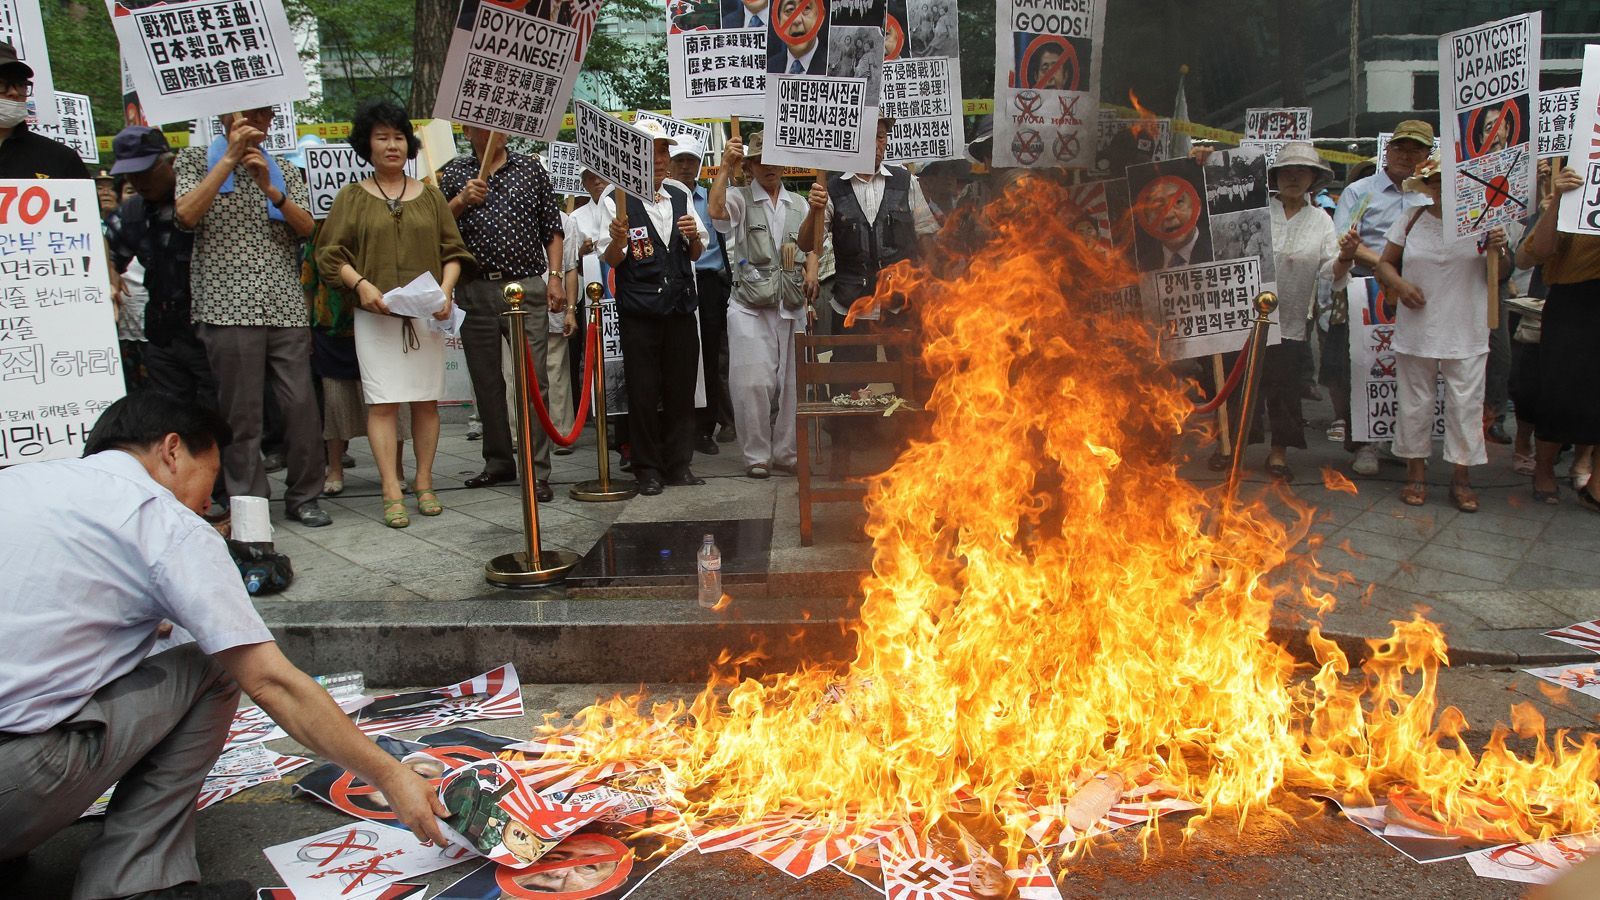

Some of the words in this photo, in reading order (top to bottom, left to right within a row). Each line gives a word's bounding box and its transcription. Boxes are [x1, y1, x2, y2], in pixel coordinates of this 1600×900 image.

[480, 9, 571, 52] BOYYCOTT!
[1016, 12, 1088, 36] GOODS!
[1456, 20, 1526, 58] BOYYCOTT!
[150, 27, 267, 65] 日本製品不買!
[474, 33, 564, 72] JAPANESE!
[1457, 44, 1526, 82] JAPANESE!
[780, 81, 860, 105] 아베담화역사진실
[1459, 68, 1525, 105] GOODS!
[579, 105, 648, 156] 강제동원부정!
[780, 103, 859, 127] 왜곡미화사죄청산
[580, 126, 648, 177] 인신매매왜곡!
[780, 126, 856, 150] 독일사죄수준미흡!
[582, 146, 648, 196] 전쟁범죄부정!
[48, 231, 91, 254] 문제
[1160, 262, 1254, 295] 강제동원부정!
